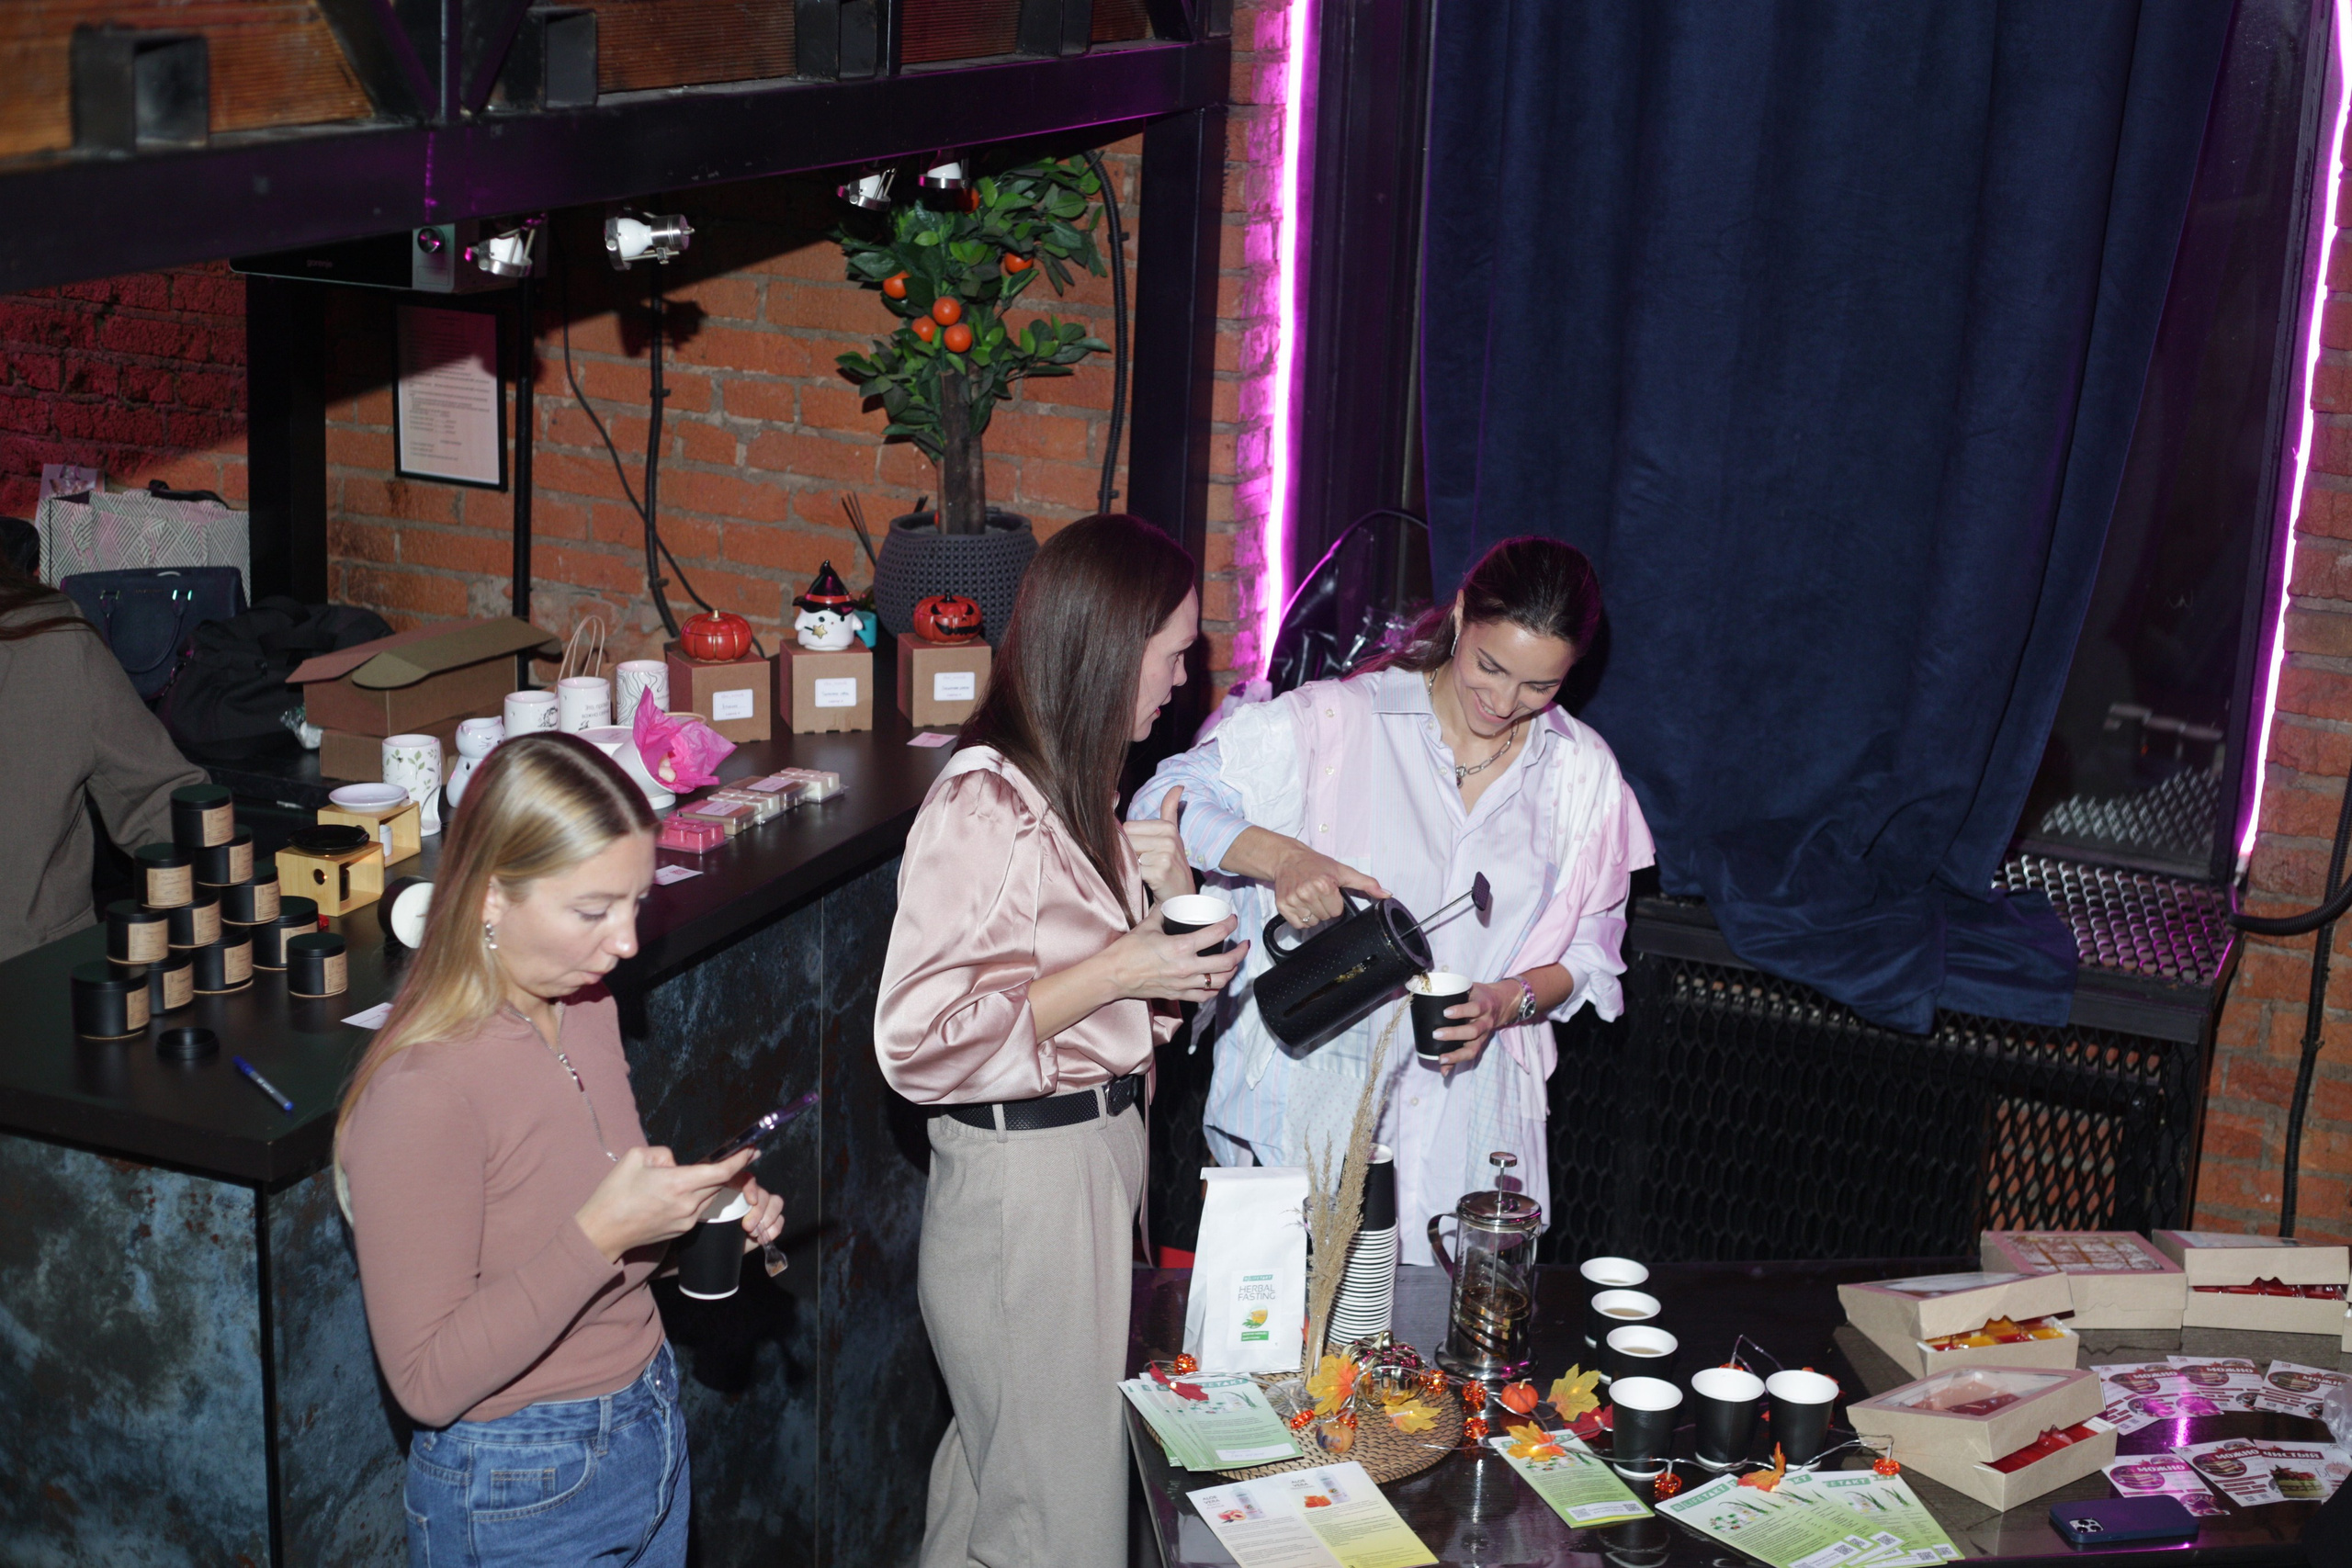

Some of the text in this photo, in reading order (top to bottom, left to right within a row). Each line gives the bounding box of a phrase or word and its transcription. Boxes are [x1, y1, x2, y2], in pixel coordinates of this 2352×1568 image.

[1238, 1284, 1275, 1293] HERBAL
[1238, 1292, 1276, 1302] FASTING
[2206, 1366, 2254, 1374] МОЖНО
[2132, 1371, 2178, 1380] МОЖНО
[2301, 1375, 2342, 1386] МОЖН
[2215, 1450, 2260, 1460] МОЖНО
[2262, 1450, 2321, 1459] ЧИСТЫЙ
[2136, 1464, 2186, 1472] МОЖНО
[1683, 1485, 1726, 1506] LIFETAKT
